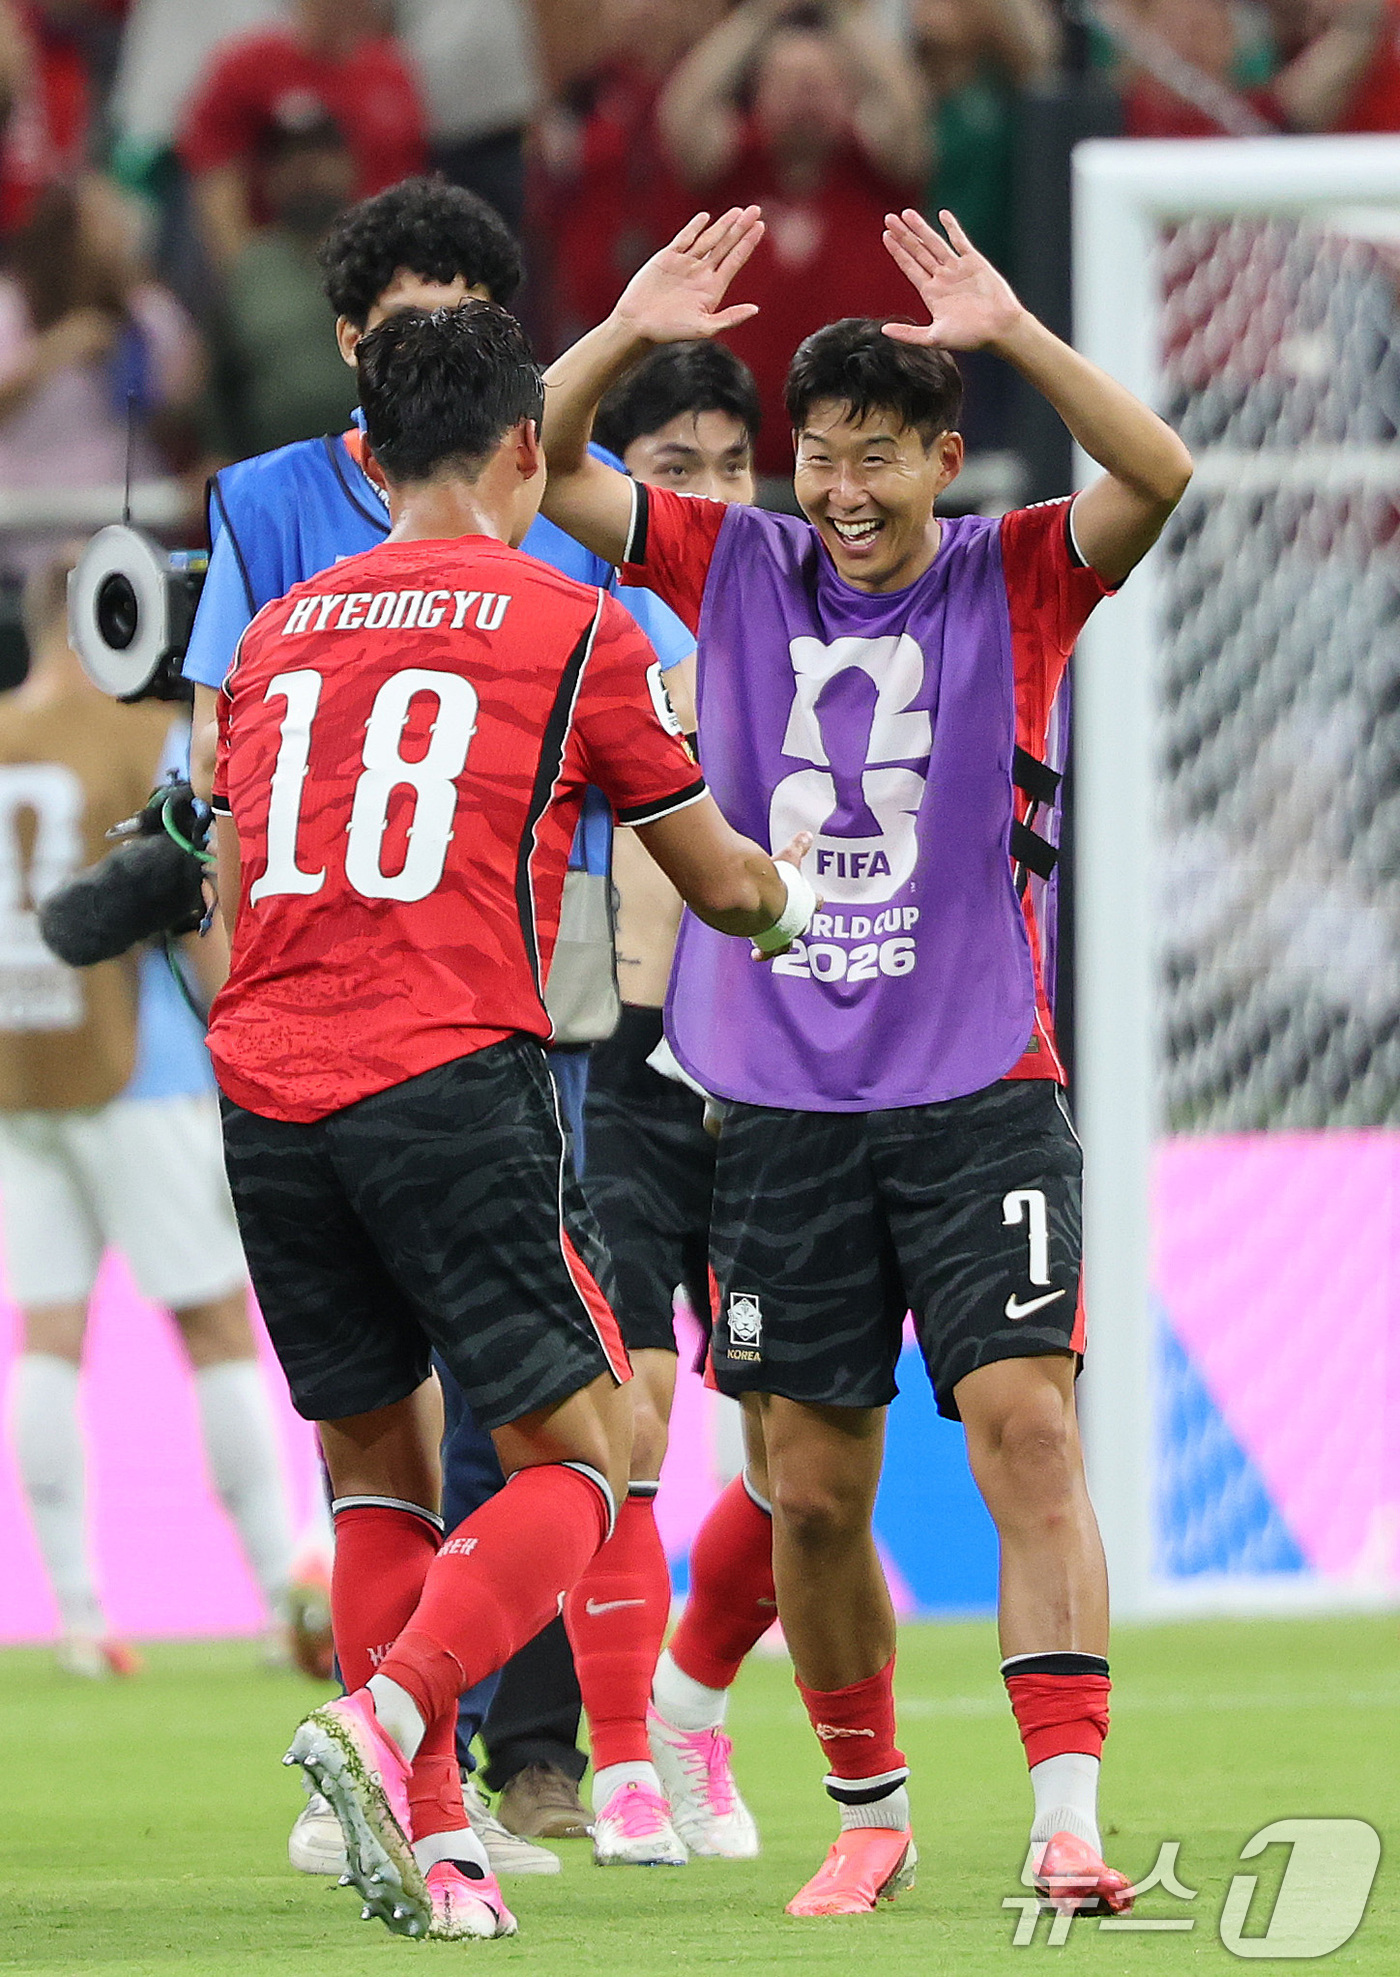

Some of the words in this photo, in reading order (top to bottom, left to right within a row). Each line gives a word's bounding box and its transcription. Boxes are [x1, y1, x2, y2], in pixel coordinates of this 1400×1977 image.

[280, 590, 512, 636] HYEONGYU
[250, 668, 479, 909] 18
[816, 848, 892, 879] FIFA
[802, 913, 872, 939] RLD
[873, 906, 920, 936] CUP
[771, 937, 917, 983] 2026
[1001, 1189, 1052, 1285] 7
[727, 1348, 762, 1363] KOREA
